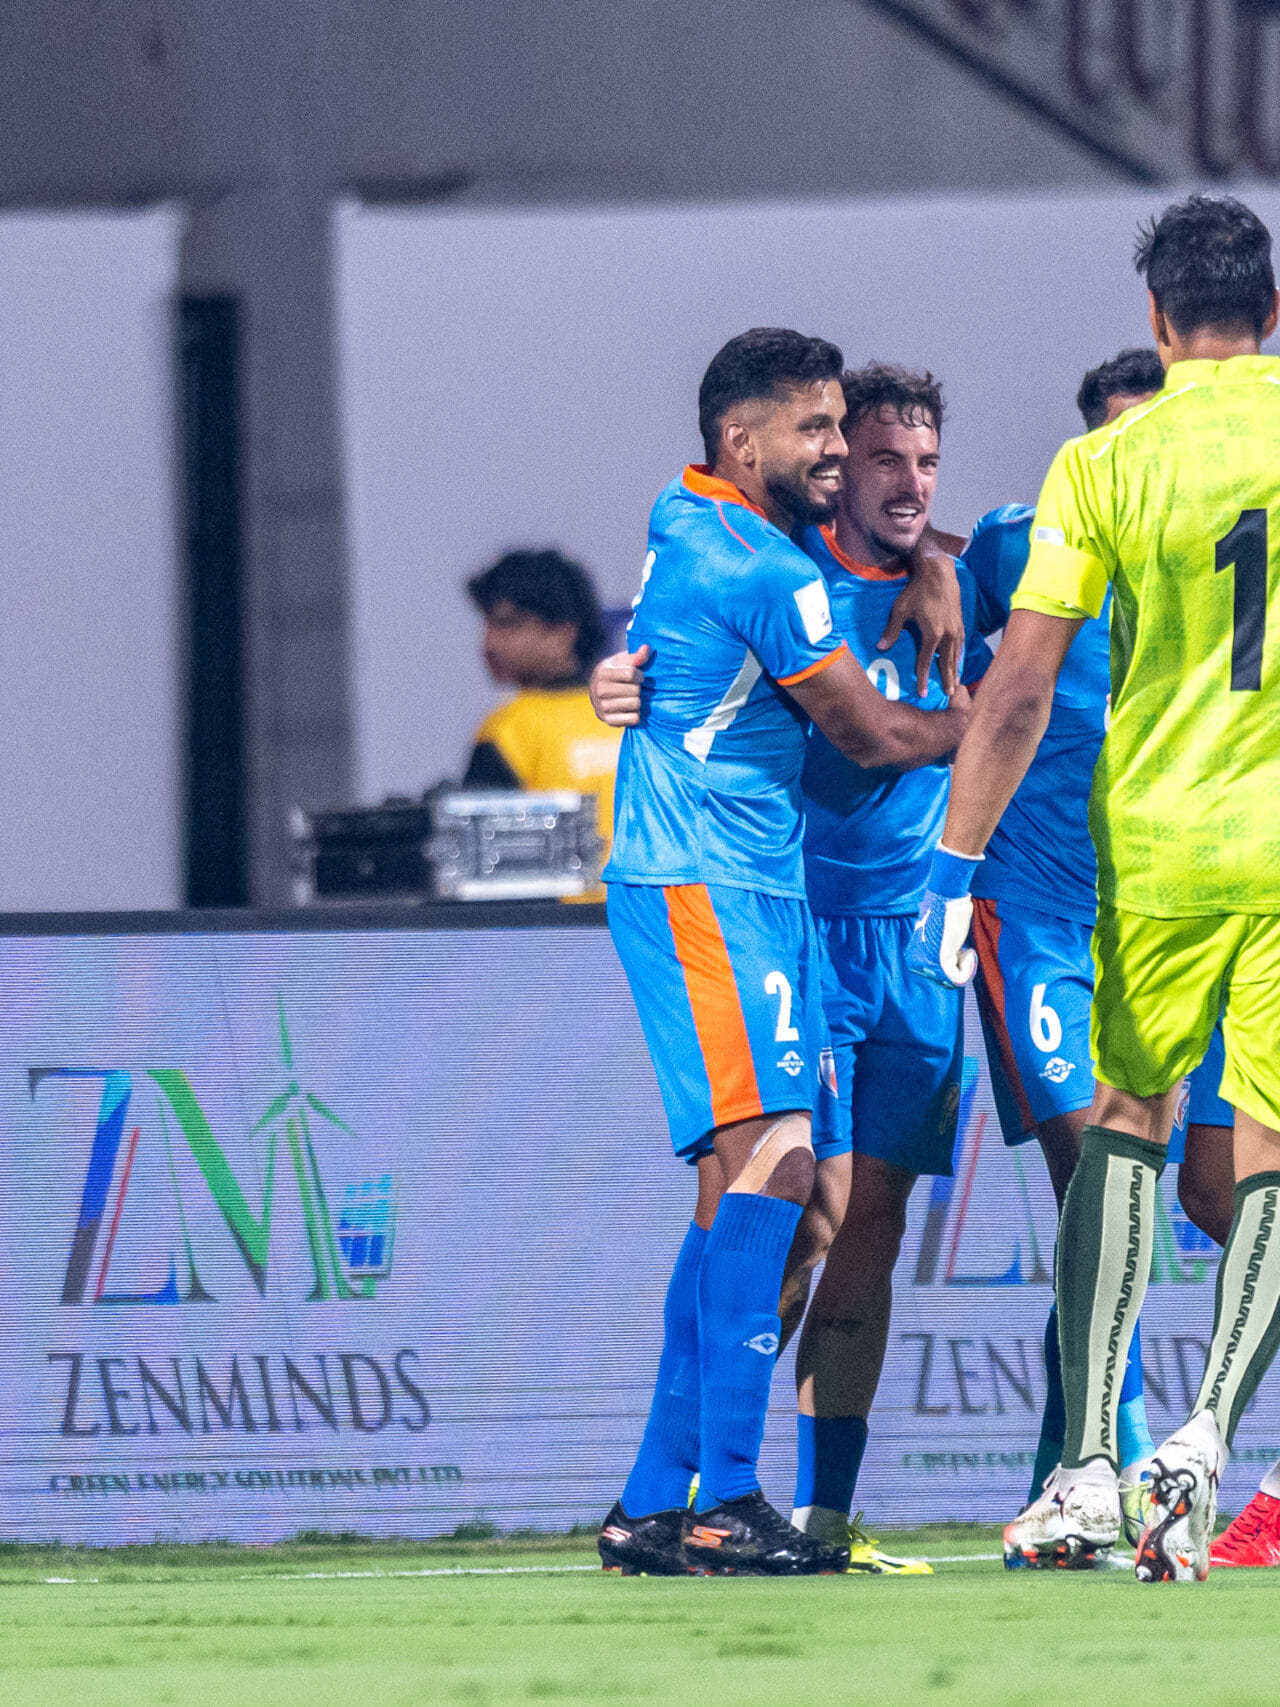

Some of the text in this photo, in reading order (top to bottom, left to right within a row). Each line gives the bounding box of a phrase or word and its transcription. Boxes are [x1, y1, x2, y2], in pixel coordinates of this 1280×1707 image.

[1214, 508, 1268, 692] 1
[764, 970, 800, 1042] 2
[1029, 983, 1063, 1053] 6
[48, 1348, 432, 1438] ZENMINDS
